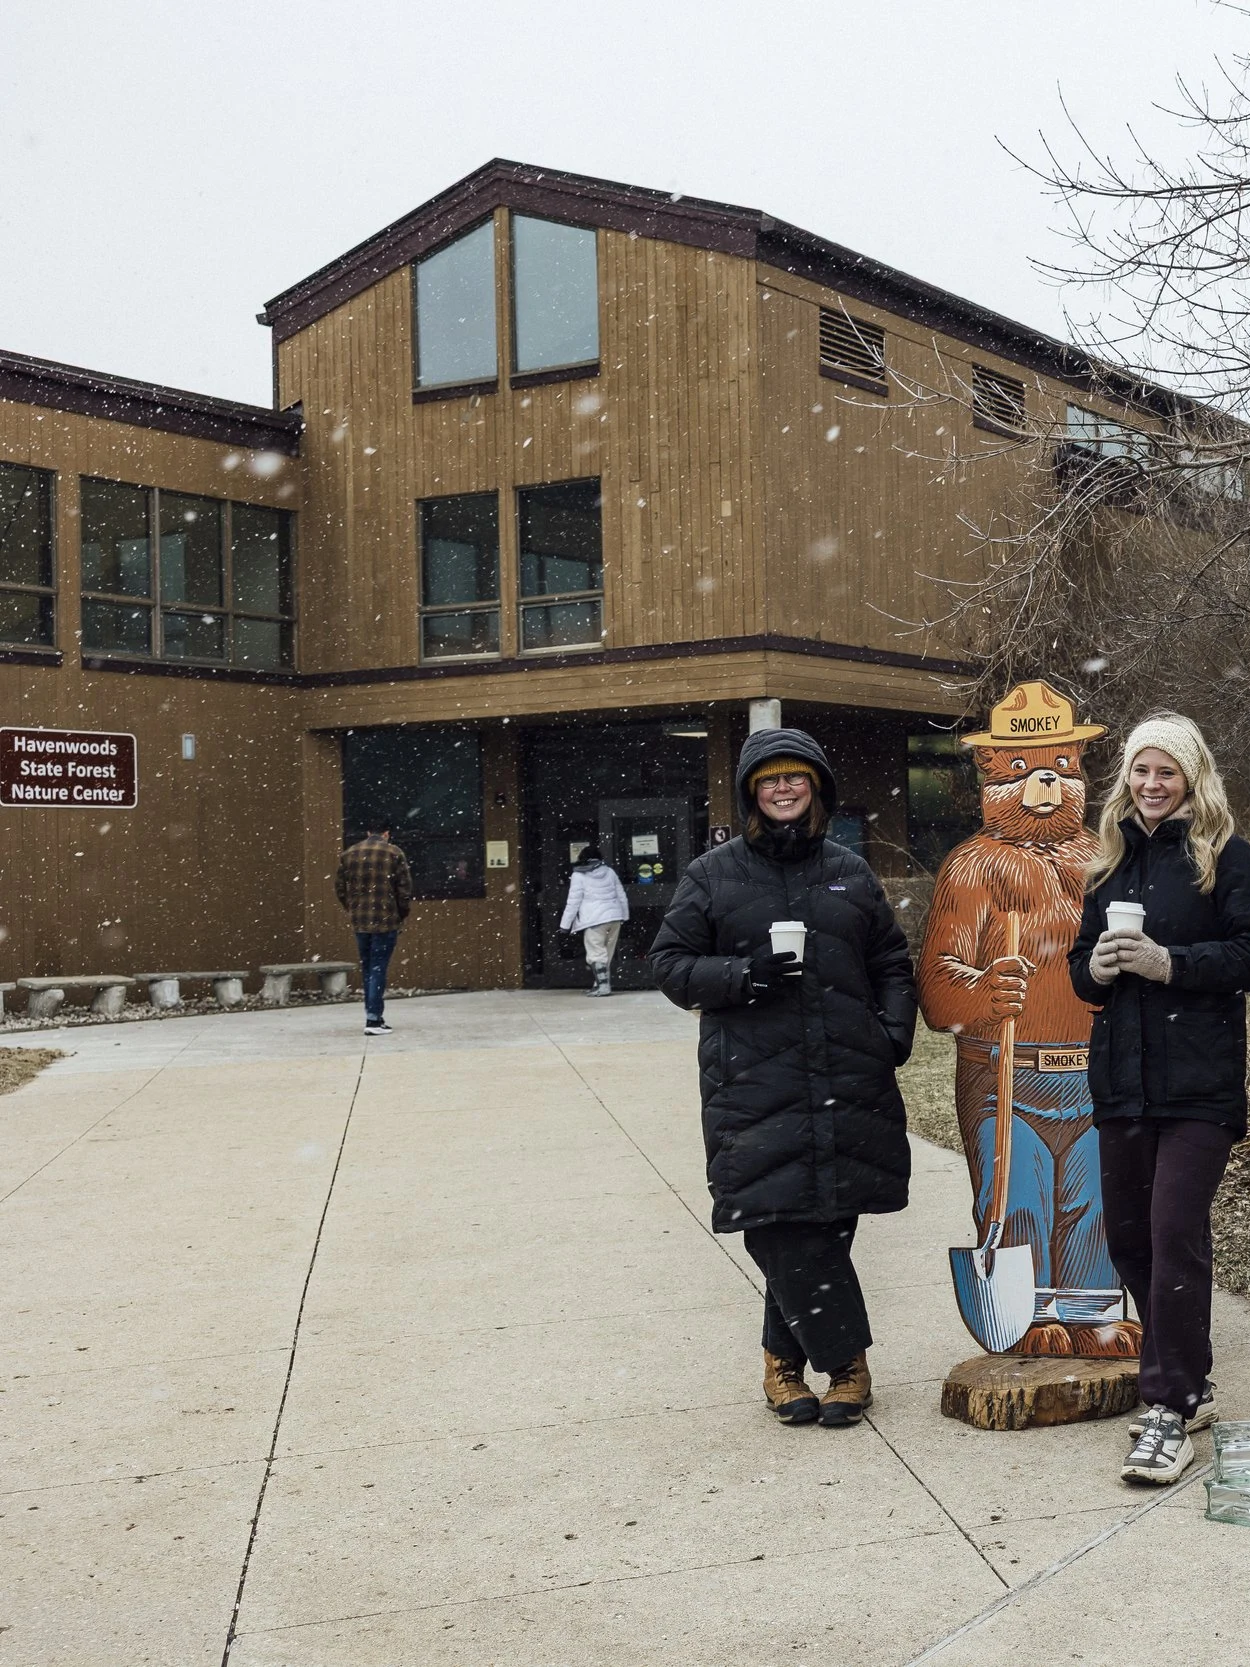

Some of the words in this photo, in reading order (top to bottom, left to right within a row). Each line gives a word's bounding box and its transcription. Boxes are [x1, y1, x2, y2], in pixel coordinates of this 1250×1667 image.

[1010, 715, 1060, 732] SMOKEY
[14, 736, 118, 755] Havenwoods
[20, 760, 63, 776] State
[67, 762, 116, 778] Forest
[11, 784, 68, 800] Nature
[73, 785, 125, 801] Center
[1044, 1054, 1090, 1066] SMOKEY
